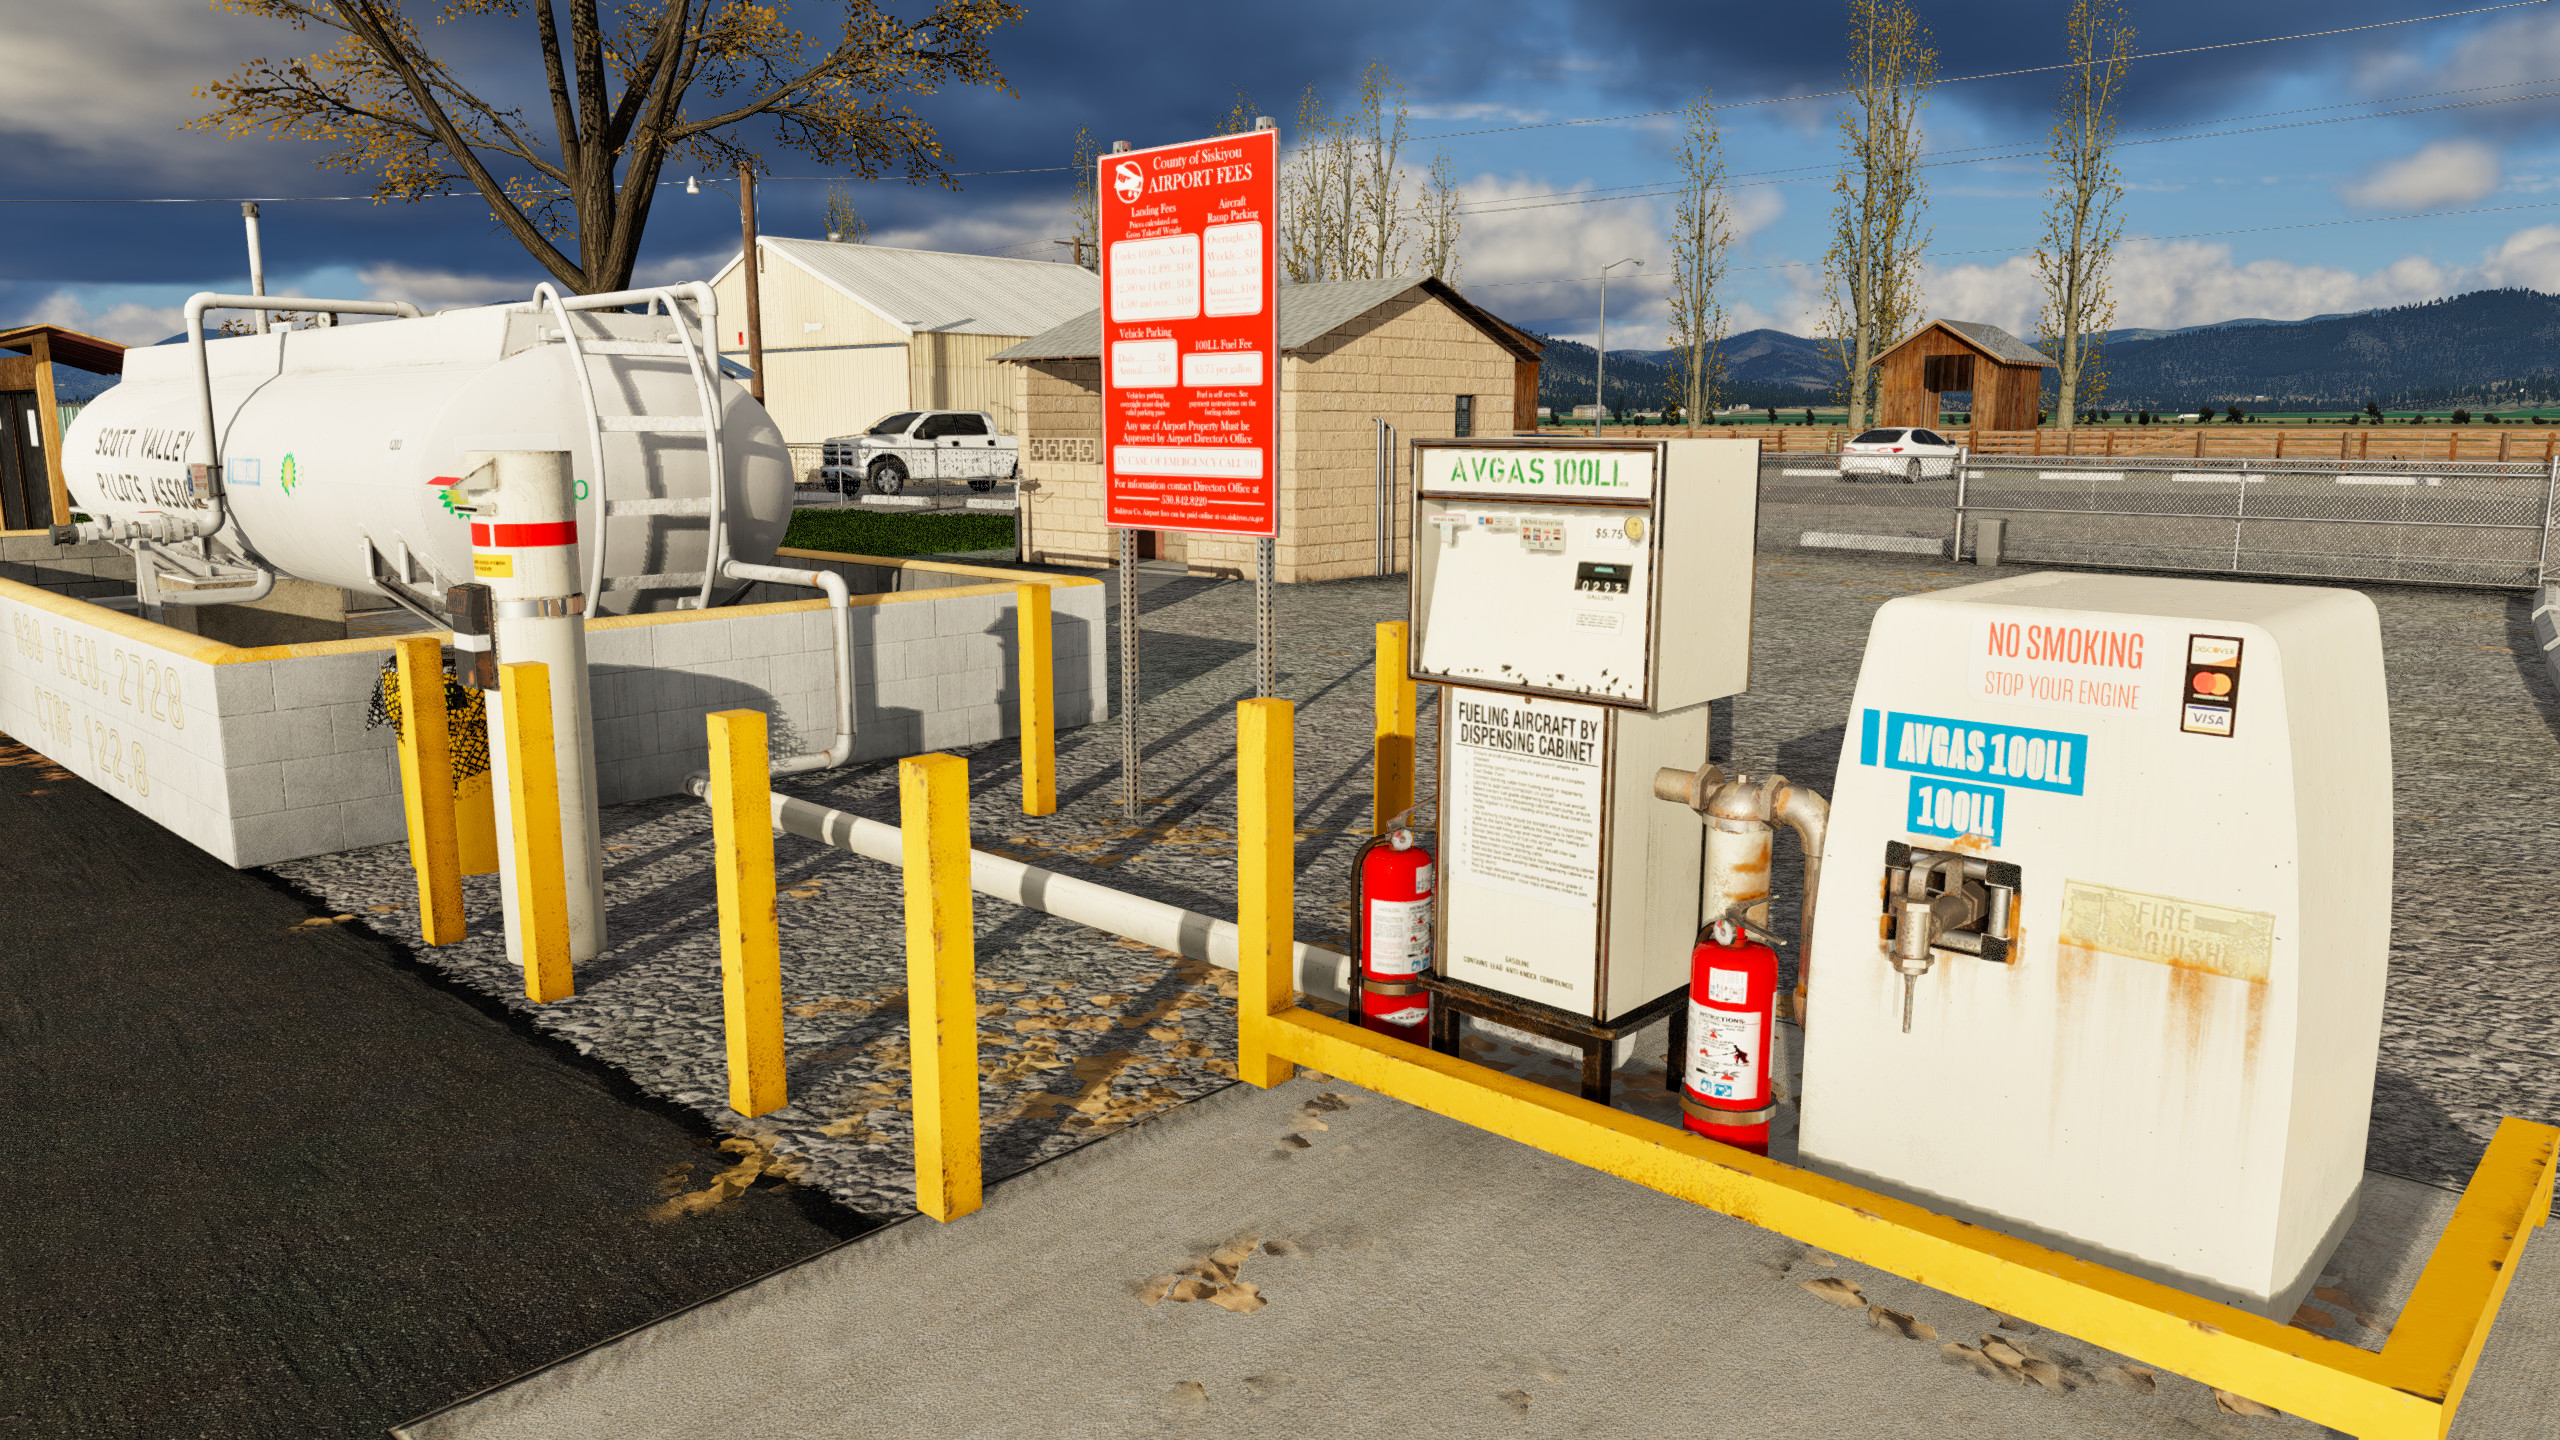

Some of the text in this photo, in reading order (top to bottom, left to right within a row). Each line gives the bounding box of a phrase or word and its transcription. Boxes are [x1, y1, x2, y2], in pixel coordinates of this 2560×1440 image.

[1153, 147, 1242, 170] County of Siskiyou
[1148, 163, 1252, 193] AIRPORT FEES
[1219, 196, 1246, 209] Aircraft
[1131, 203, 1177, 217] Landing Fees
[1207, 208, 1259, 224] Ramp Parking
[1182, 245, 1195, 255] Fee
[1139, 297, 1152, 308] and
[1119, 327, 1172, 339] Vehicle Parking
[1195, 338, 1252, 351] 100LL Fuel Fee
[1216, 366, 1229, 377] per
[1230, 363, 1252, 376] gallon
[1125, 420, 1250, 434] Any use of Airport Property Must be
[95, 428, 195, 463] SCOTT VALLEY
[1123, 433, 1253, 445] Approved by Airport Director's Office
[1117, 455, 1128, 465] IN
[1128, 456, 1150, 466] CASE
[1163, 456, 1217, 468] EMERGENCY
[1219, 457, 1240, 468] CALL
[1450, 456, 1629, 487] AVGAS 100LL
[96, 472, 147, 504] PILOTS
[1115, 478, 1260, 493] For information contact Directors Office at
[1114, 507, 1132, 516] Siskiyou
[1143, 508, 1160, 518] Airport
[1594, 527, 1624, 540] $5.75
[1987, 621, 2145, 671] NO SMOKING
[2194, 645, 2235, 655] DISCOVER
[114, 648, 185, 731] 2728
[1984, 670, 2142, 711] STOP YOUR ENGINE
[1458, 701, 1598, 741] FUELING AIRCRAFT BY
[2193, 712, 2224, 726] VISA
[34, 685, 149, 797] CTAF 122.8
[1460, 723, 1595, 763] DISPENSING CABINET
[1898, 721, 2073, 786] AVGAS 100LL
[1916, 786, 1995, 838] 100LL
[2135, 901, 2192, 933] FIRE
[1463, 955, 1488, 968] CONTAINS
[1505, 955, 1530, 968] GASOLINE
